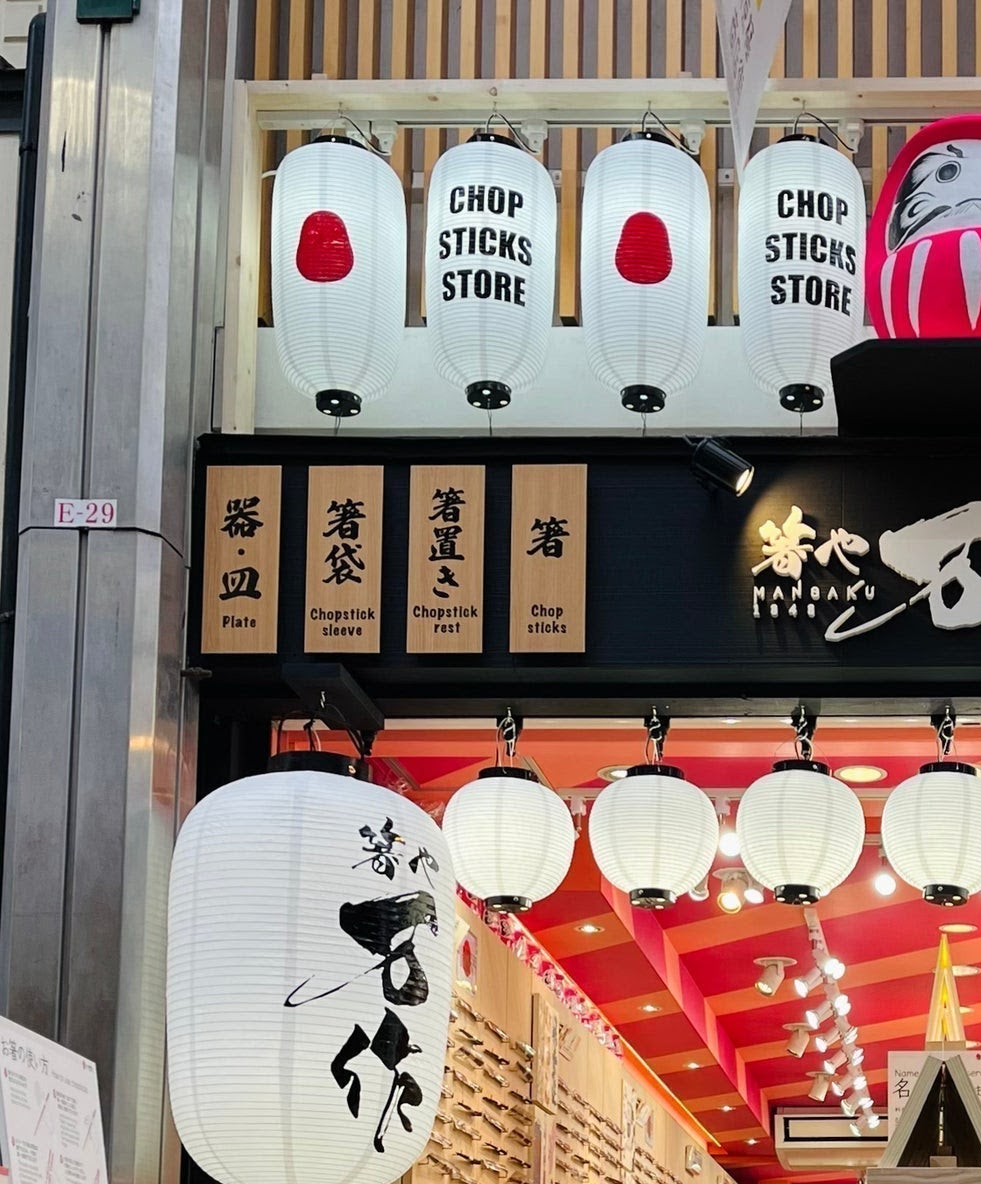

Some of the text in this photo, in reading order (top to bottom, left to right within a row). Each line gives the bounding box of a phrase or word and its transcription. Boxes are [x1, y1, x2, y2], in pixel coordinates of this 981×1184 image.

[449, 185, 524, 217] CHOP
[777, 189, 849, 225] CHOP
[439, 227, 533, 266] STICKS
[765, 232, 856, 275] STICKS
[442, 269, 526, 307] STORE
[770, 274, 851, 317] STORE
[57, 502, 115, 524] E-29
[322, 498, 367, 586] 箸袋
[427, 486, 467, 598] 箸置き
[525, 515, 571, 559] 箸
[222, 614, 257, 629] Plate
[310, 606, 375, 623] Chopstick
[412, 604, 478, 620] Chopstick
[530, 603, 564, 620] Chop
[321, 623, 363, 637] sleeve
[433, 620, 461, 634] rest
[527, 619, 567, 634] sticks
[894, 1069, 919, 1077] Name
